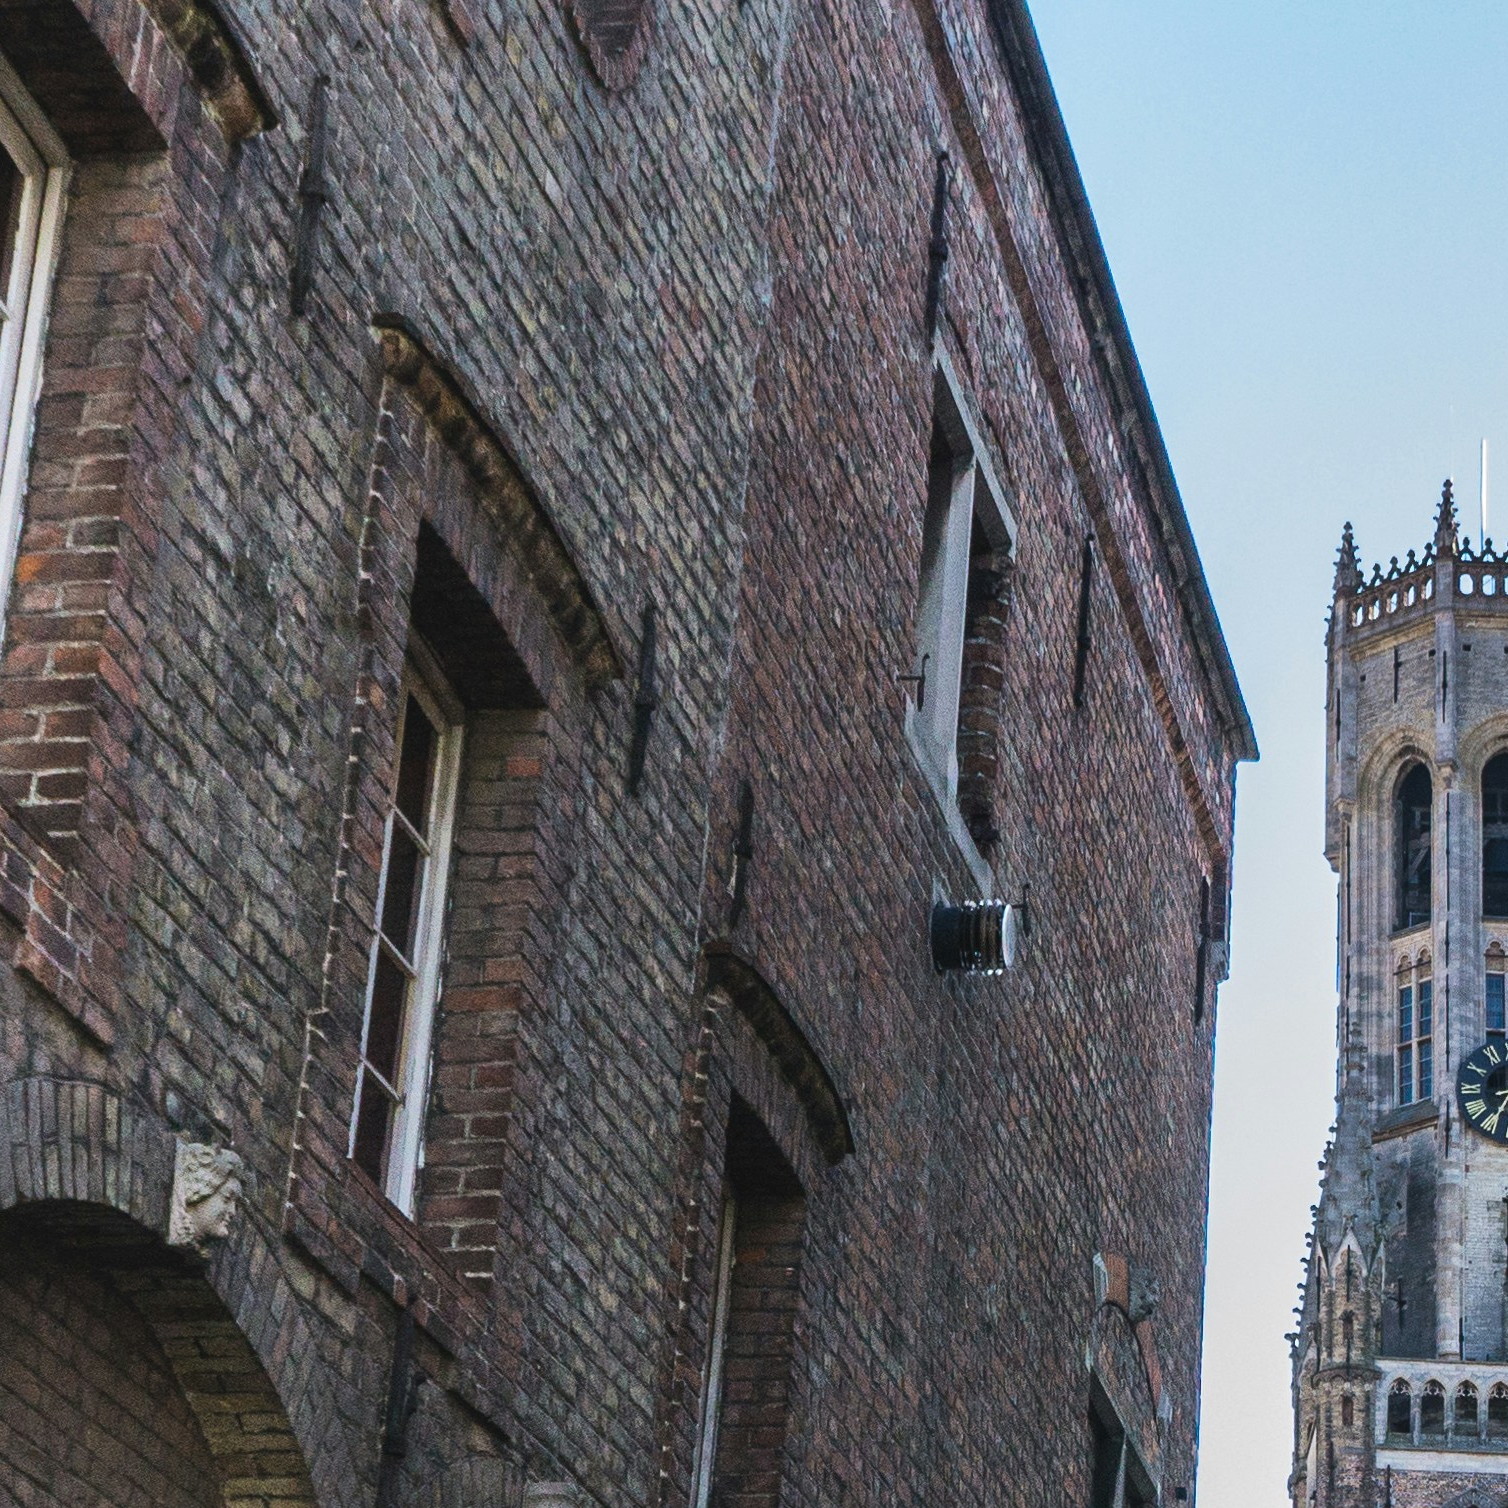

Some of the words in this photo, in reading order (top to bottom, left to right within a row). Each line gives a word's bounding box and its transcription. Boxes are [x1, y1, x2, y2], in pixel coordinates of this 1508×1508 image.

[1483, 1045, 1501, 1066] XI
[1467, 1062, 1487, 1076] X
[1461, 1082, 1481, 1094] IX
[1465, 1099, 1487, 1120] VIII
[1480, 1113, 1499, 1134] VII
